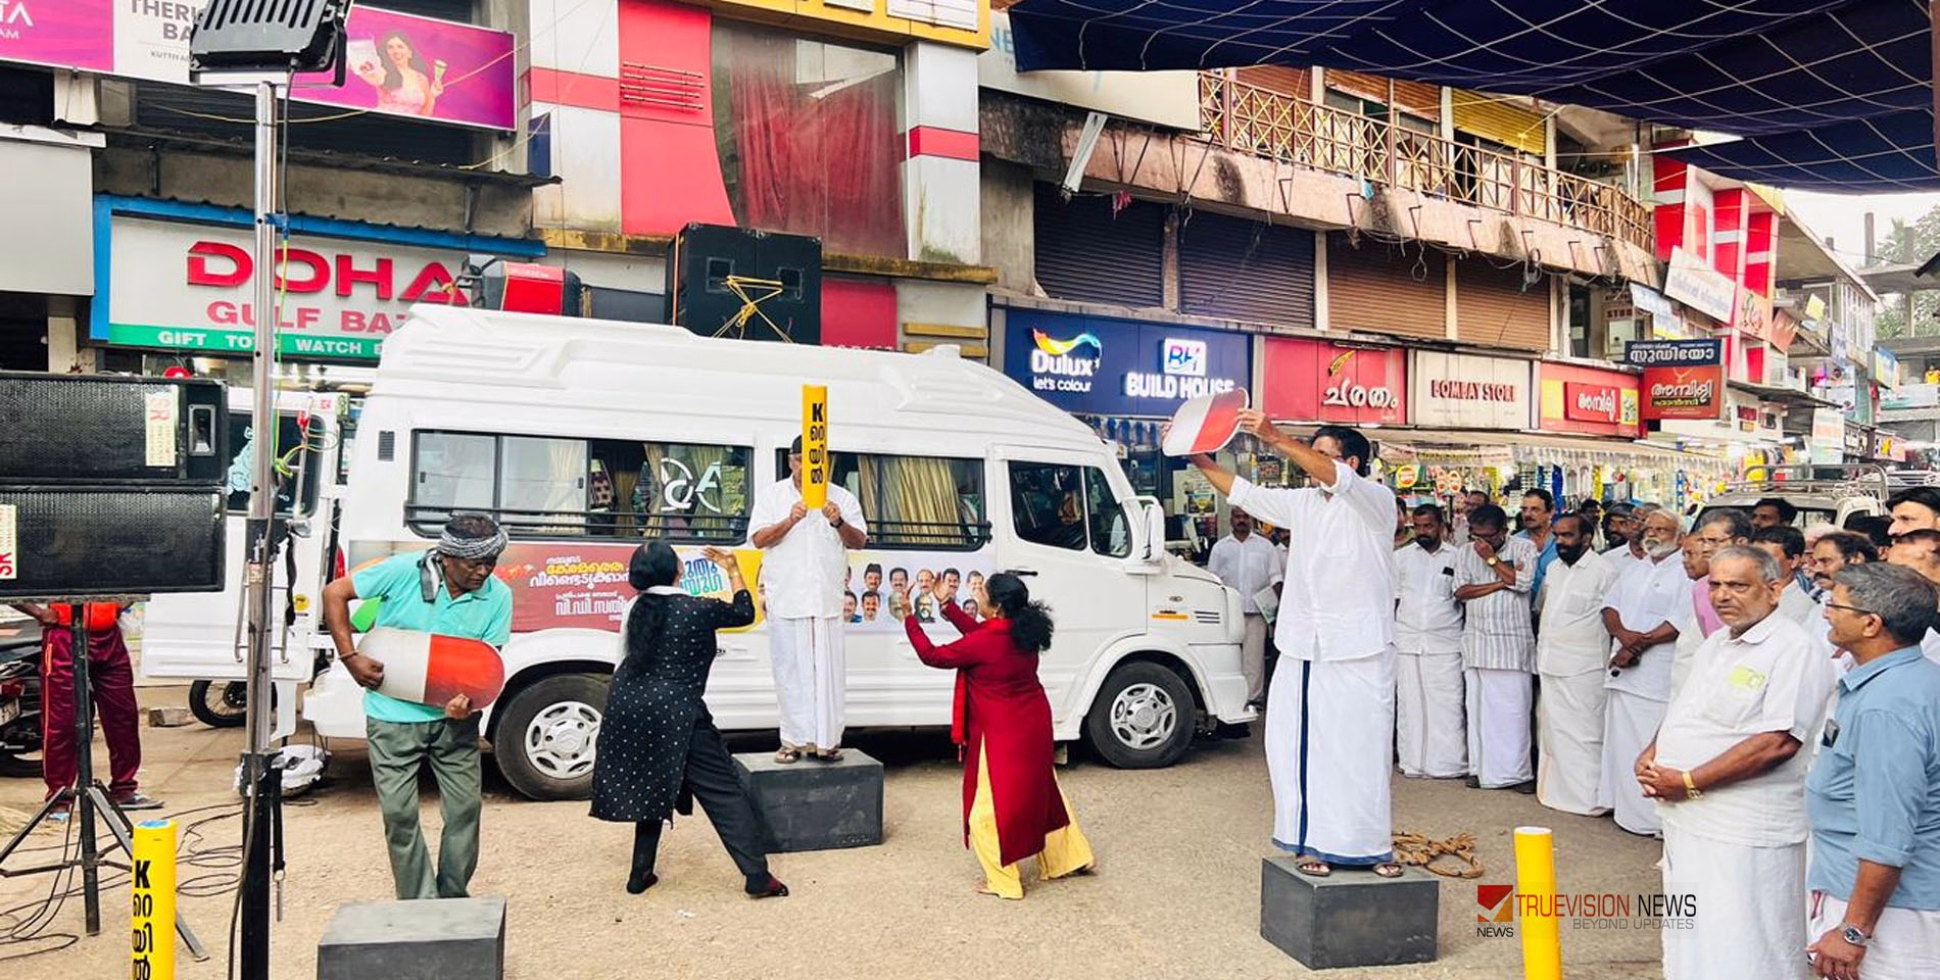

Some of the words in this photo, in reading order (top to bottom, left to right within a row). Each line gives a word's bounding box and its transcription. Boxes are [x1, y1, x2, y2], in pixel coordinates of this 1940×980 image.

[163, 22, 191, 42] BA
[187, 241, 470, 306] DOHA
[340, 310, 407, 334] BA
[158, 331, 207, 346] GIFT
[225, 334, 279, 350] TOS
[295, 338, 362, 354] WATCH
[1031, 348, 1093, 377] Dulux
[1033, 376, 1055, 390] let's
[1057, 377, 1091, 393] colour
[1126, 372, 1178, 398] BUILD
[1431, 379, 1480, 400] BOMBAY
